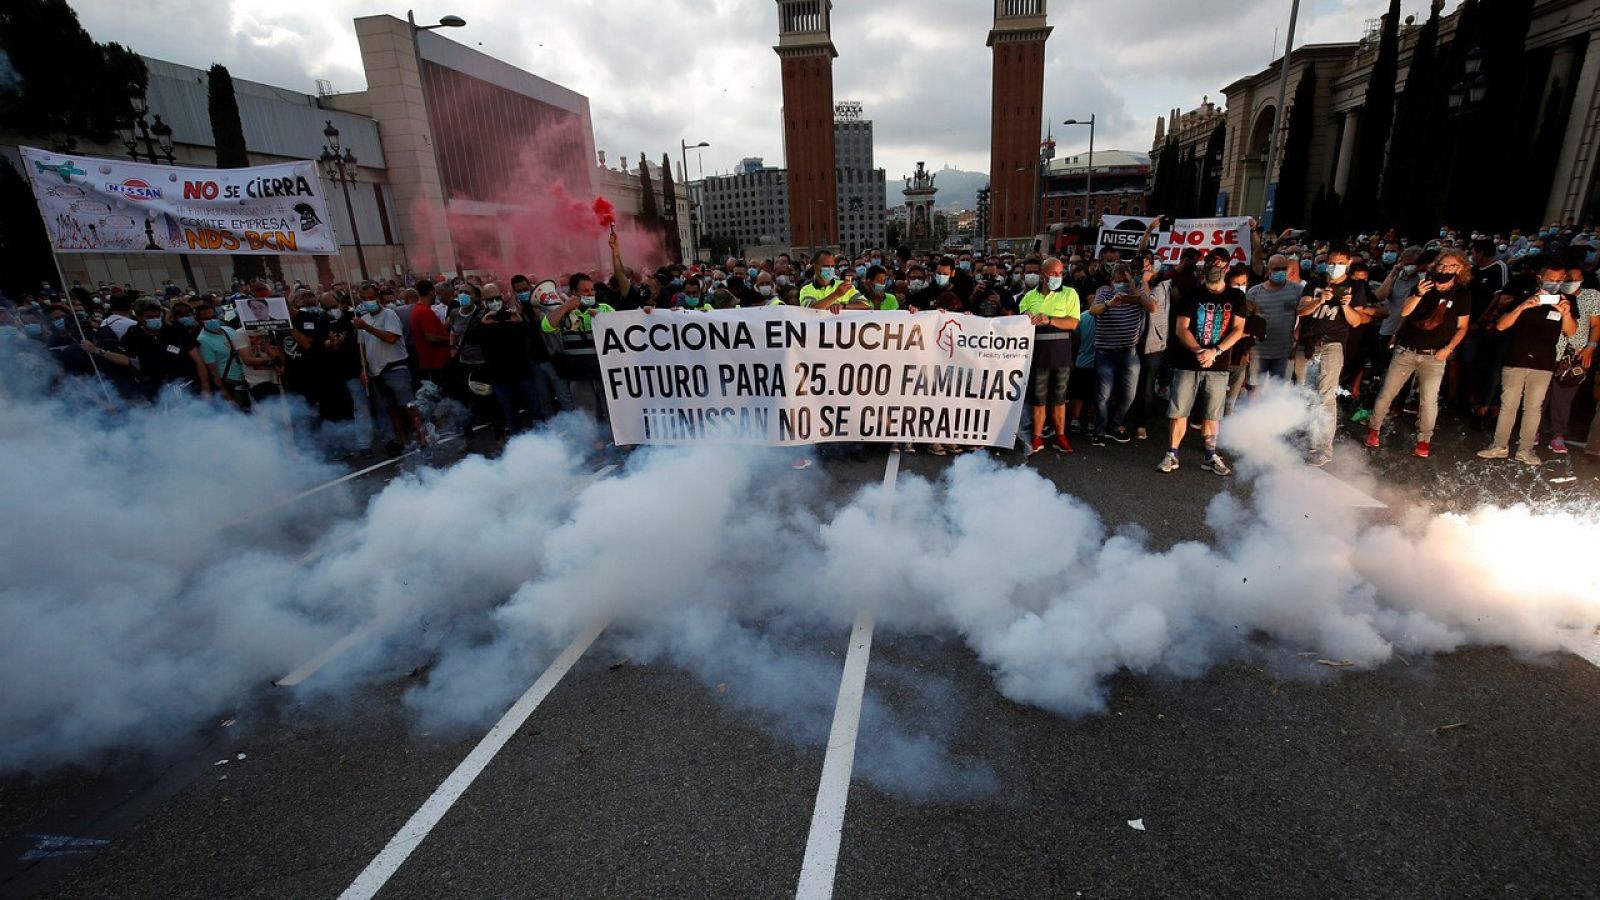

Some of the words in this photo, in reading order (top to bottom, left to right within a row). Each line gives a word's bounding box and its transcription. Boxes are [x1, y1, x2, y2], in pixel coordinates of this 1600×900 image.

[109, 184, 161, 198] NISSAN
[183, 181, 219, 200] NO
[224, 185, 240, 198] SE
[231, 217, 290, 230] EMPRESA
[184, 228, 298, 251] NDS-BCN
[1169, 230, 1204, 245] NO
[1210, 230, 1239, 245] SE
[602, 321, 756, 355] ACCIONA
[765, 320, 807, 348] EN
[819, 321, 925, 350] LUCHA
[957, 331, 1030, 350] acciona
[608, 364, 709, 399] FUTURO
[718, 363, 787, 397] PARA
[794, 362, 892, 396] 25.000
[900, 364, 1024, 401] FAMILIAS
[779, 406, 811, 441] NO
[820, 405, 850, 437] SE
[859, 405, 991, 441] CIERRA!!!!
